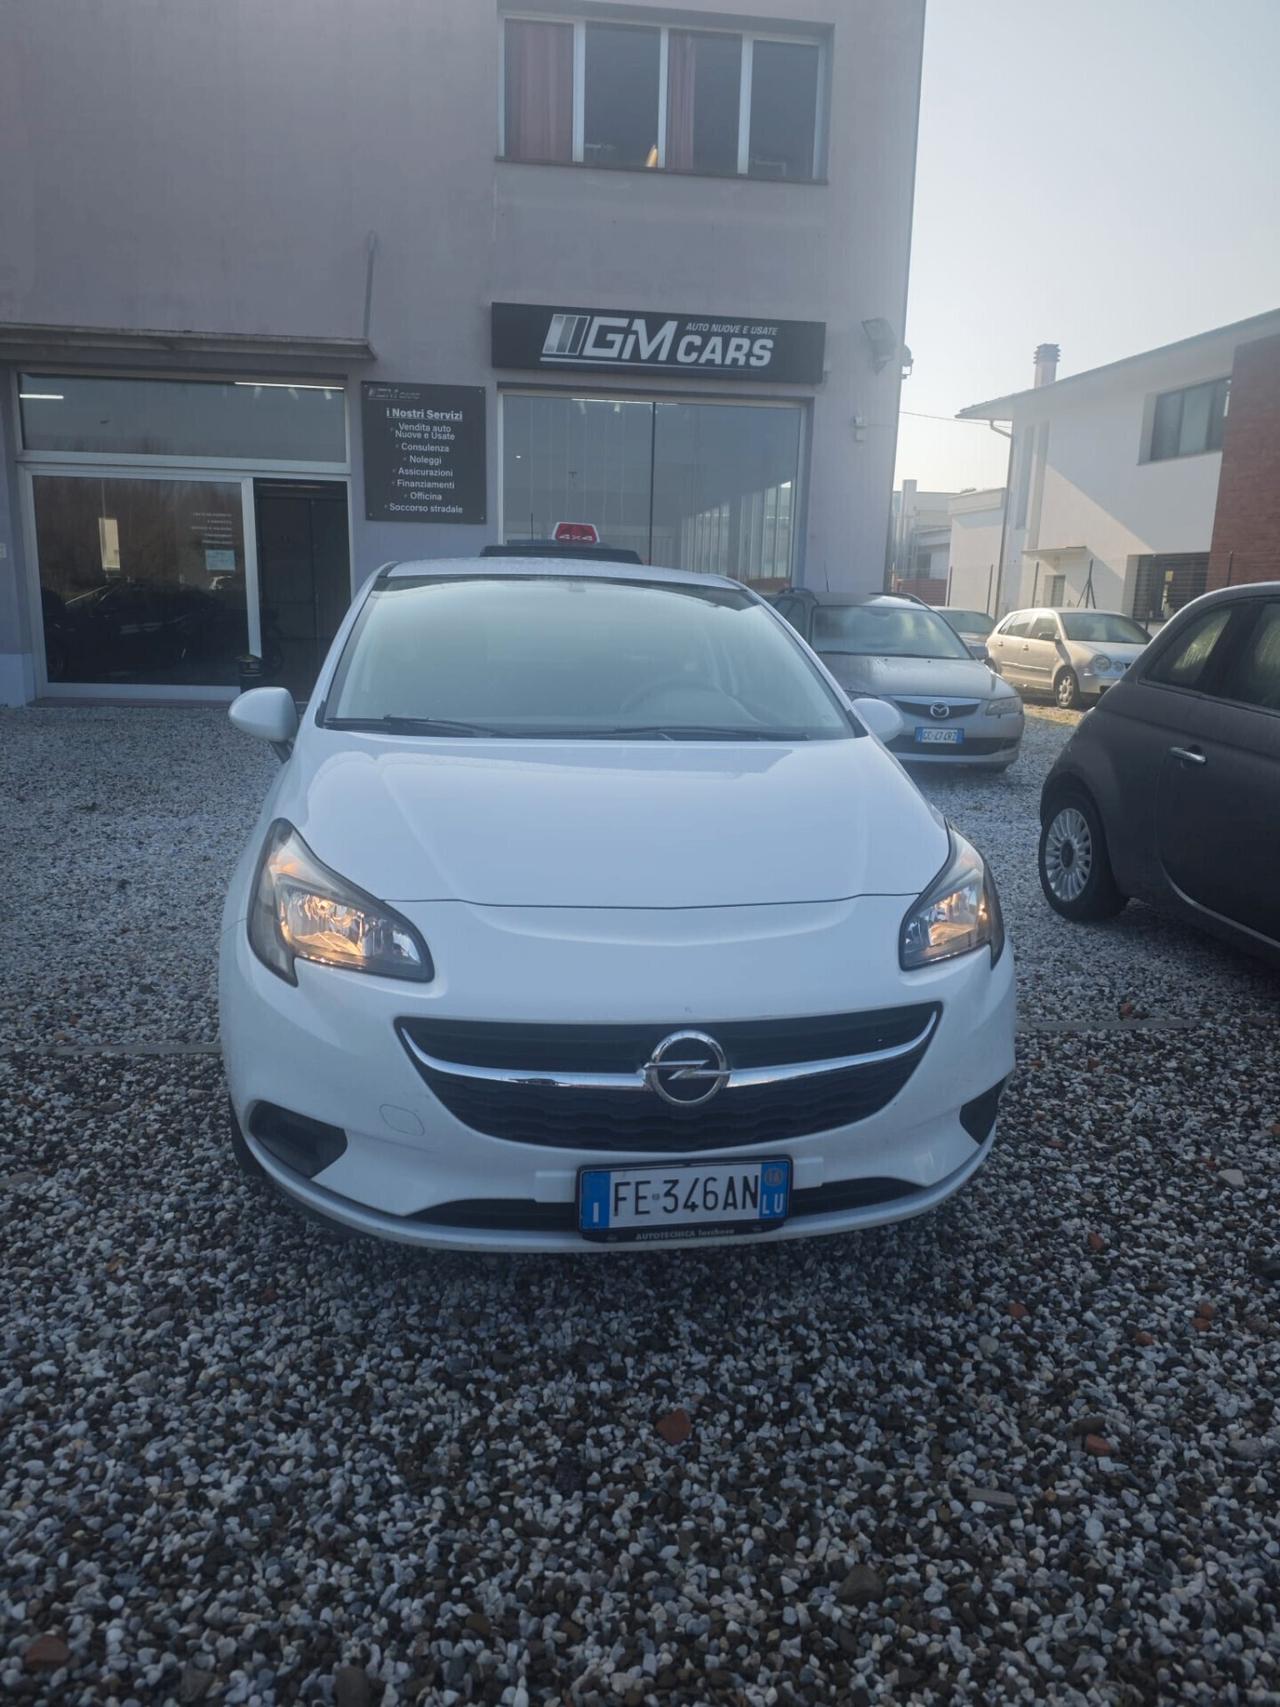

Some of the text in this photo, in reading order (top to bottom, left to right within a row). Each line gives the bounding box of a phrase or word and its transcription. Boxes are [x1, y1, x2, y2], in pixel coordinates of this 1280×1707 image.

[685, 322, 778, 336] AUTO NUOVE E USATE
[582, 315, 775, 368] GM CARS
[392, 408, 425, 418] Nostri
[426, 410, 463, 420] Servizi
[398, 422, 452, 433] Vendita auto
[395, 430, 422, 440] Nuove
[431, 432, 456, 441] Usate
[401, 442, 450, 452] Consulenza
[409, 455, 442, 466] Noleggi
[398, 467, 454, 477] Assicurazioni
[397, 479, 455, 489] Finanziamenti
[409, 491, 443, 501] Officina
[389, 502, 464, 514] Soccorso stradale
[761, 1193, 785, 1215] LU
